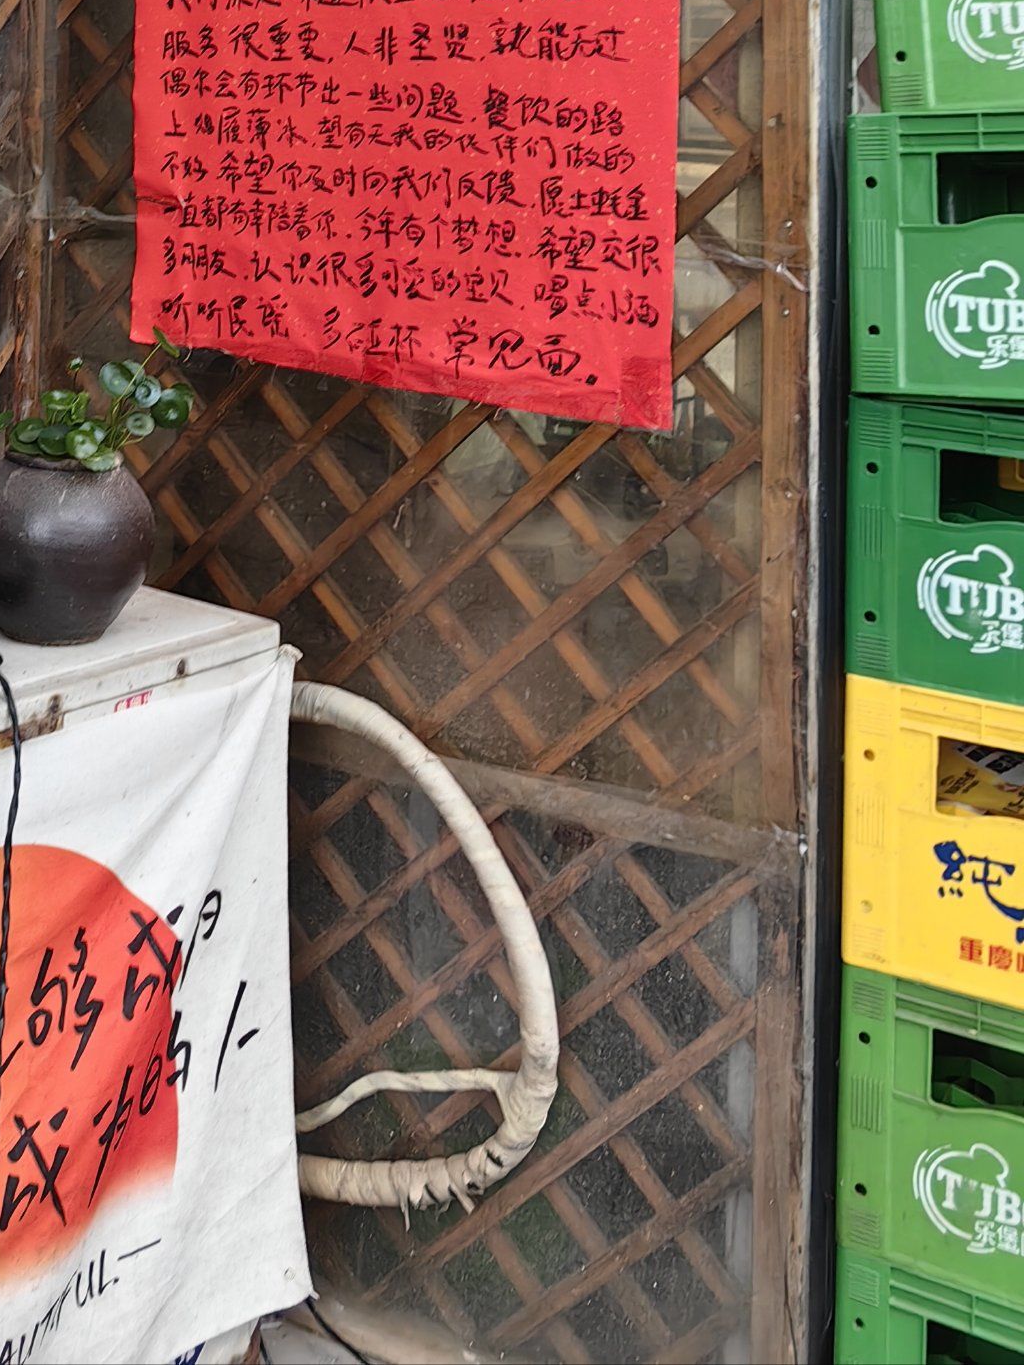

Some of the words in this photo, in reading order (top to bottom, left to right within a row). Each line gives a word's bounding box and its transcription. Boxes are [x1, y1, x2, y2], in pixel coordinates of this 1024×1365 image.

[948, 294, 1024, 333] TUB
[959, 936, 1024, 973] 重慶
[974, 1220, 1024, 1257] 乐堡
